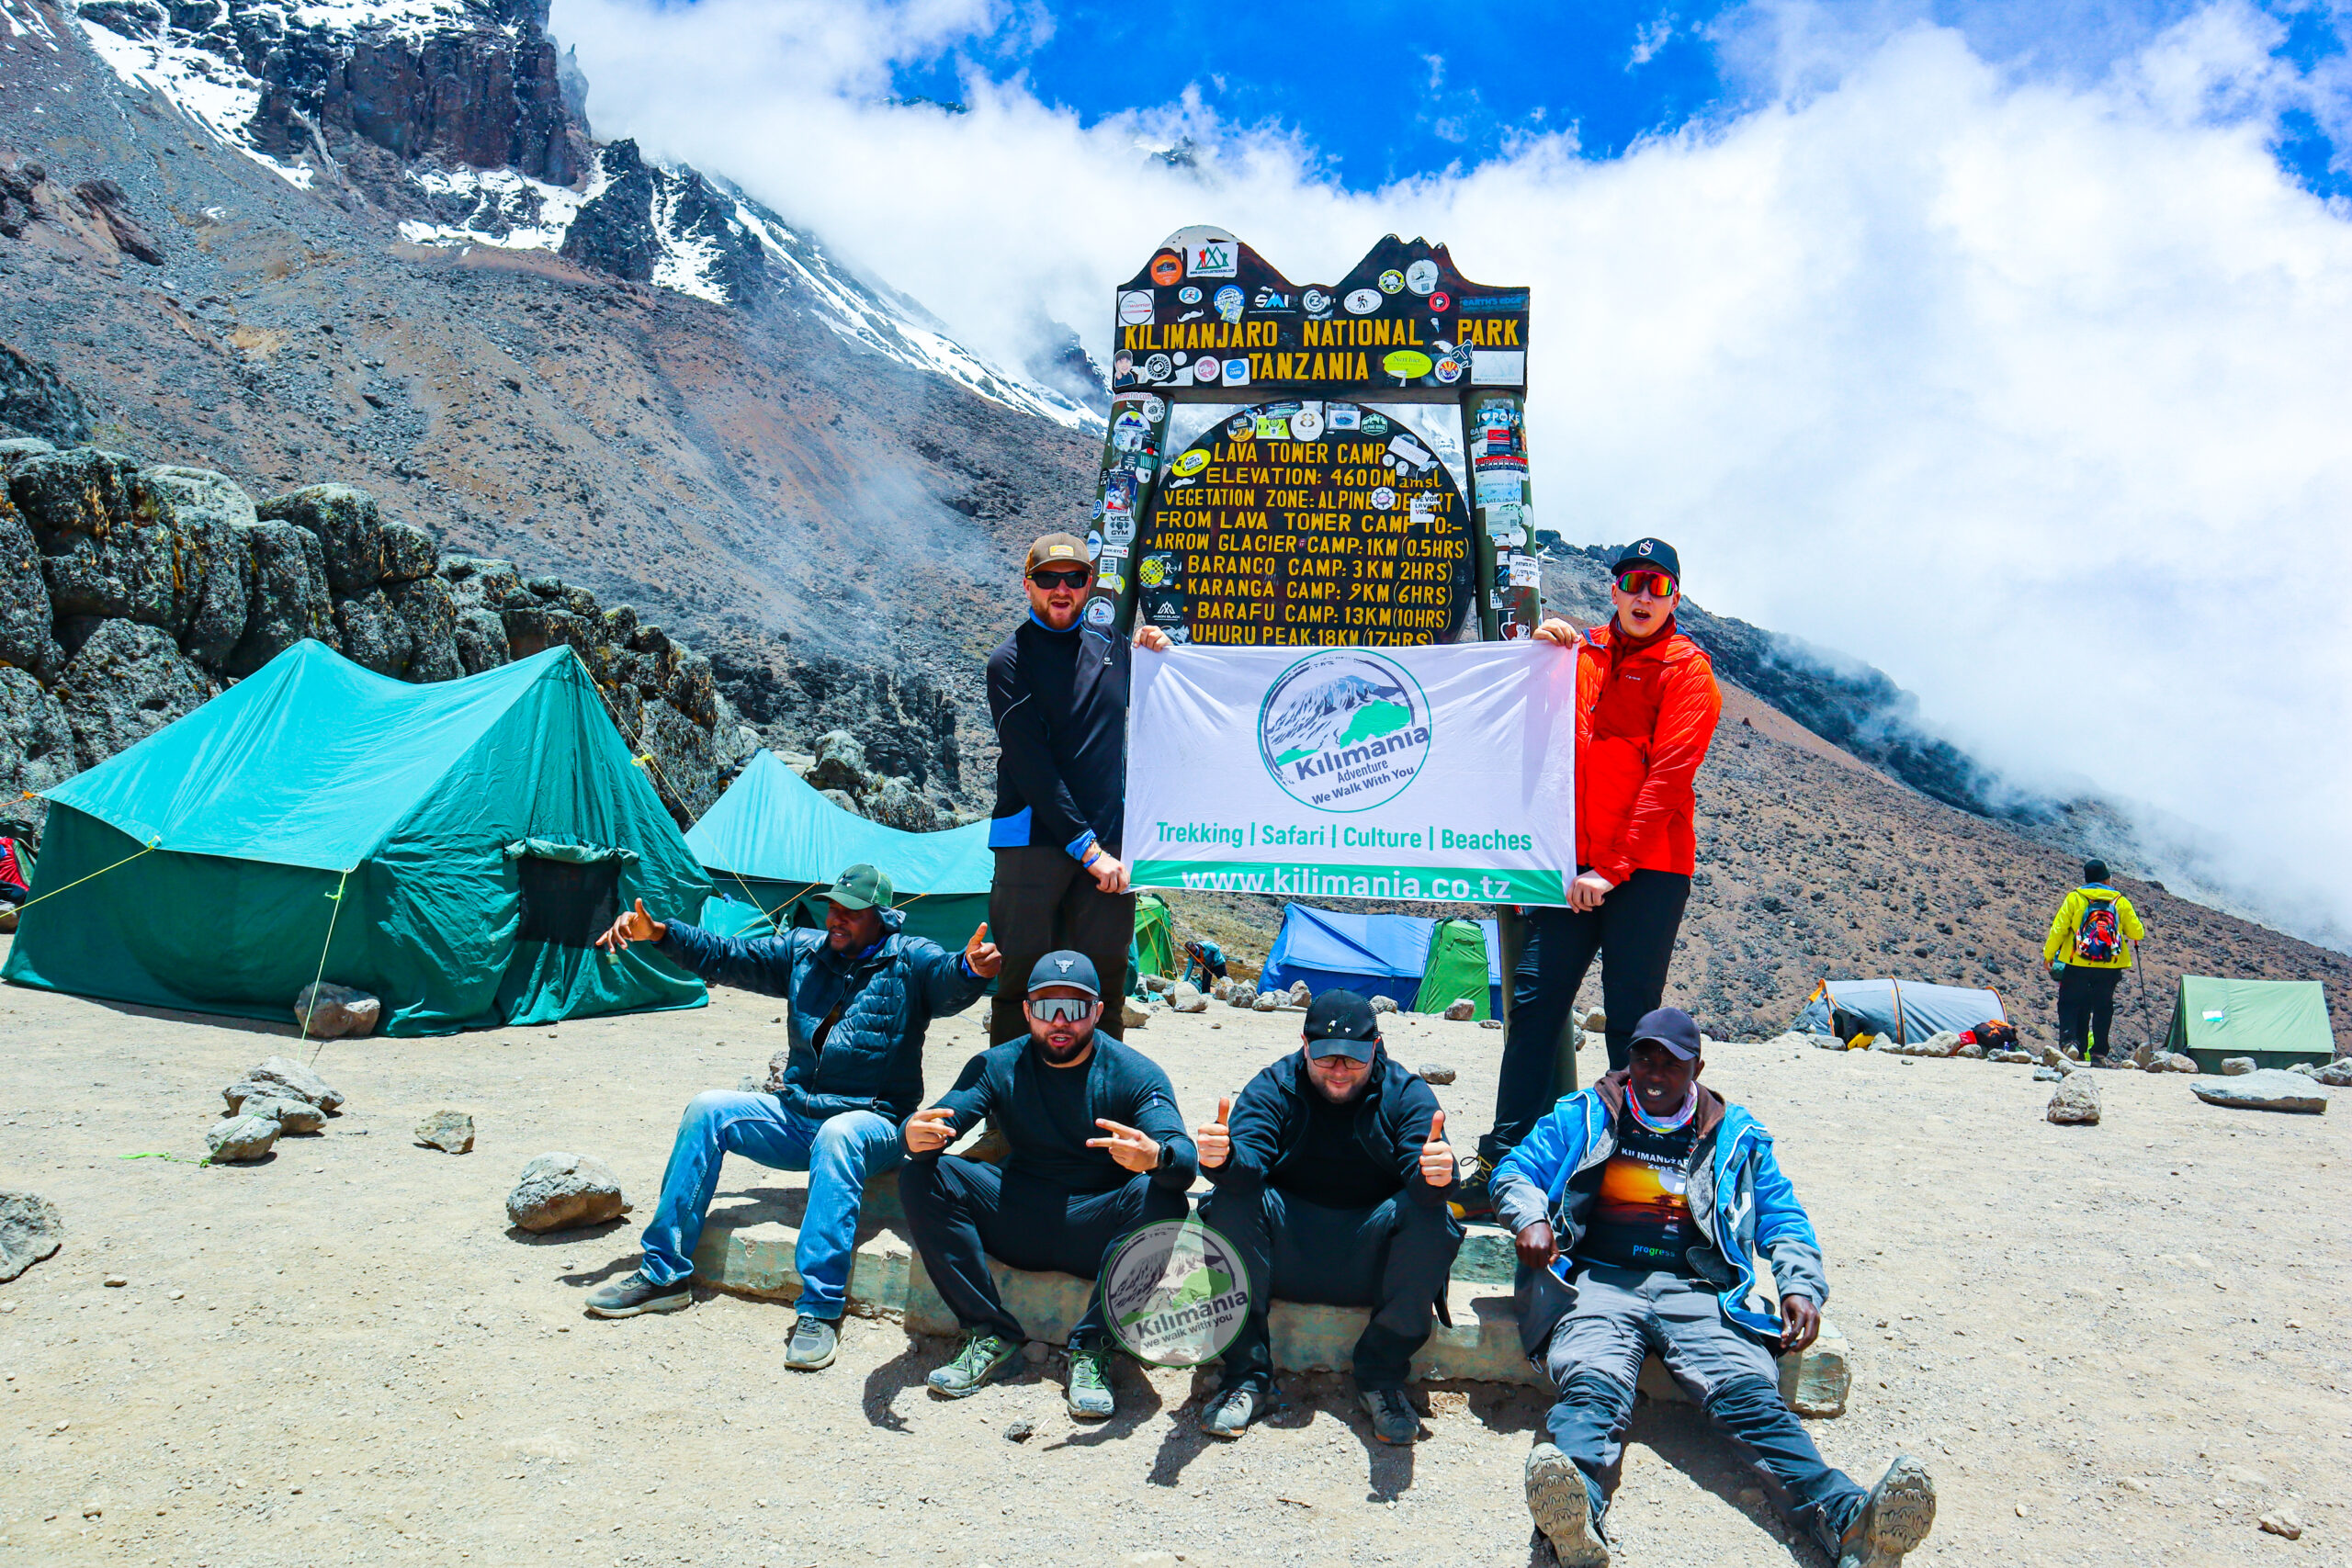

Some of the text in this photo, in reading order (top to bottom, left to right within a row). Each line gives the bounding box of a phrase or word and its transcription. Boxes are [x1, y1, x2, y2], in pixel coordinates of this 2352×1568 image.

[1125, 318, 1519, 350] KILIMANJARO NATIONAL PARK
[1249, 352, 1369, 381] TANZANIA
[1214, 442, 1385, 465] LAVA TOWER CAMP
[1206, 467, 1442, 489] ELEVATION: 4600M amsl
[1164, 488, 1255, 506] VEGETATION
[1266, 489, 1315, 509] ZONE:
[1392, 491, 1454, 514] DERT
[1156, 511, 1211, 529] FROM
[1220, 511, 1269, 530] LAVA
[1283, 513, 1351, 532] TOWER
[1361, 514, 1416, 535] CAMP
[1155, 532, 1210, 550] ARROW
[1218, 534, 1297, 553] GLACIER
[1188, 555, 1276, 576] BARANCO
[1288, 558, 1347, 578] CAMP:
[1400, 559, 1453, 584] 2HRS)
[1188, 578, 1275, 598] KARANGA
[1286, 581, 1341, 601] CAMP:
[1197, 601, 1276, 622] BARAFU
[1284, 604, 1340, 625] CAMP:
[1192, 623, 1257, 645] UHURU
[1337, 760, 1389, 784] Adventure
[1311, 766, 1415, 805] We Walk With You
[1157, 821, 1532, 852] Trekking Safari Culture Beaches
[1182, 867, 1511, 899] www.kilimania.co.tz
[1633, 1245, 1676, 1257] progress
